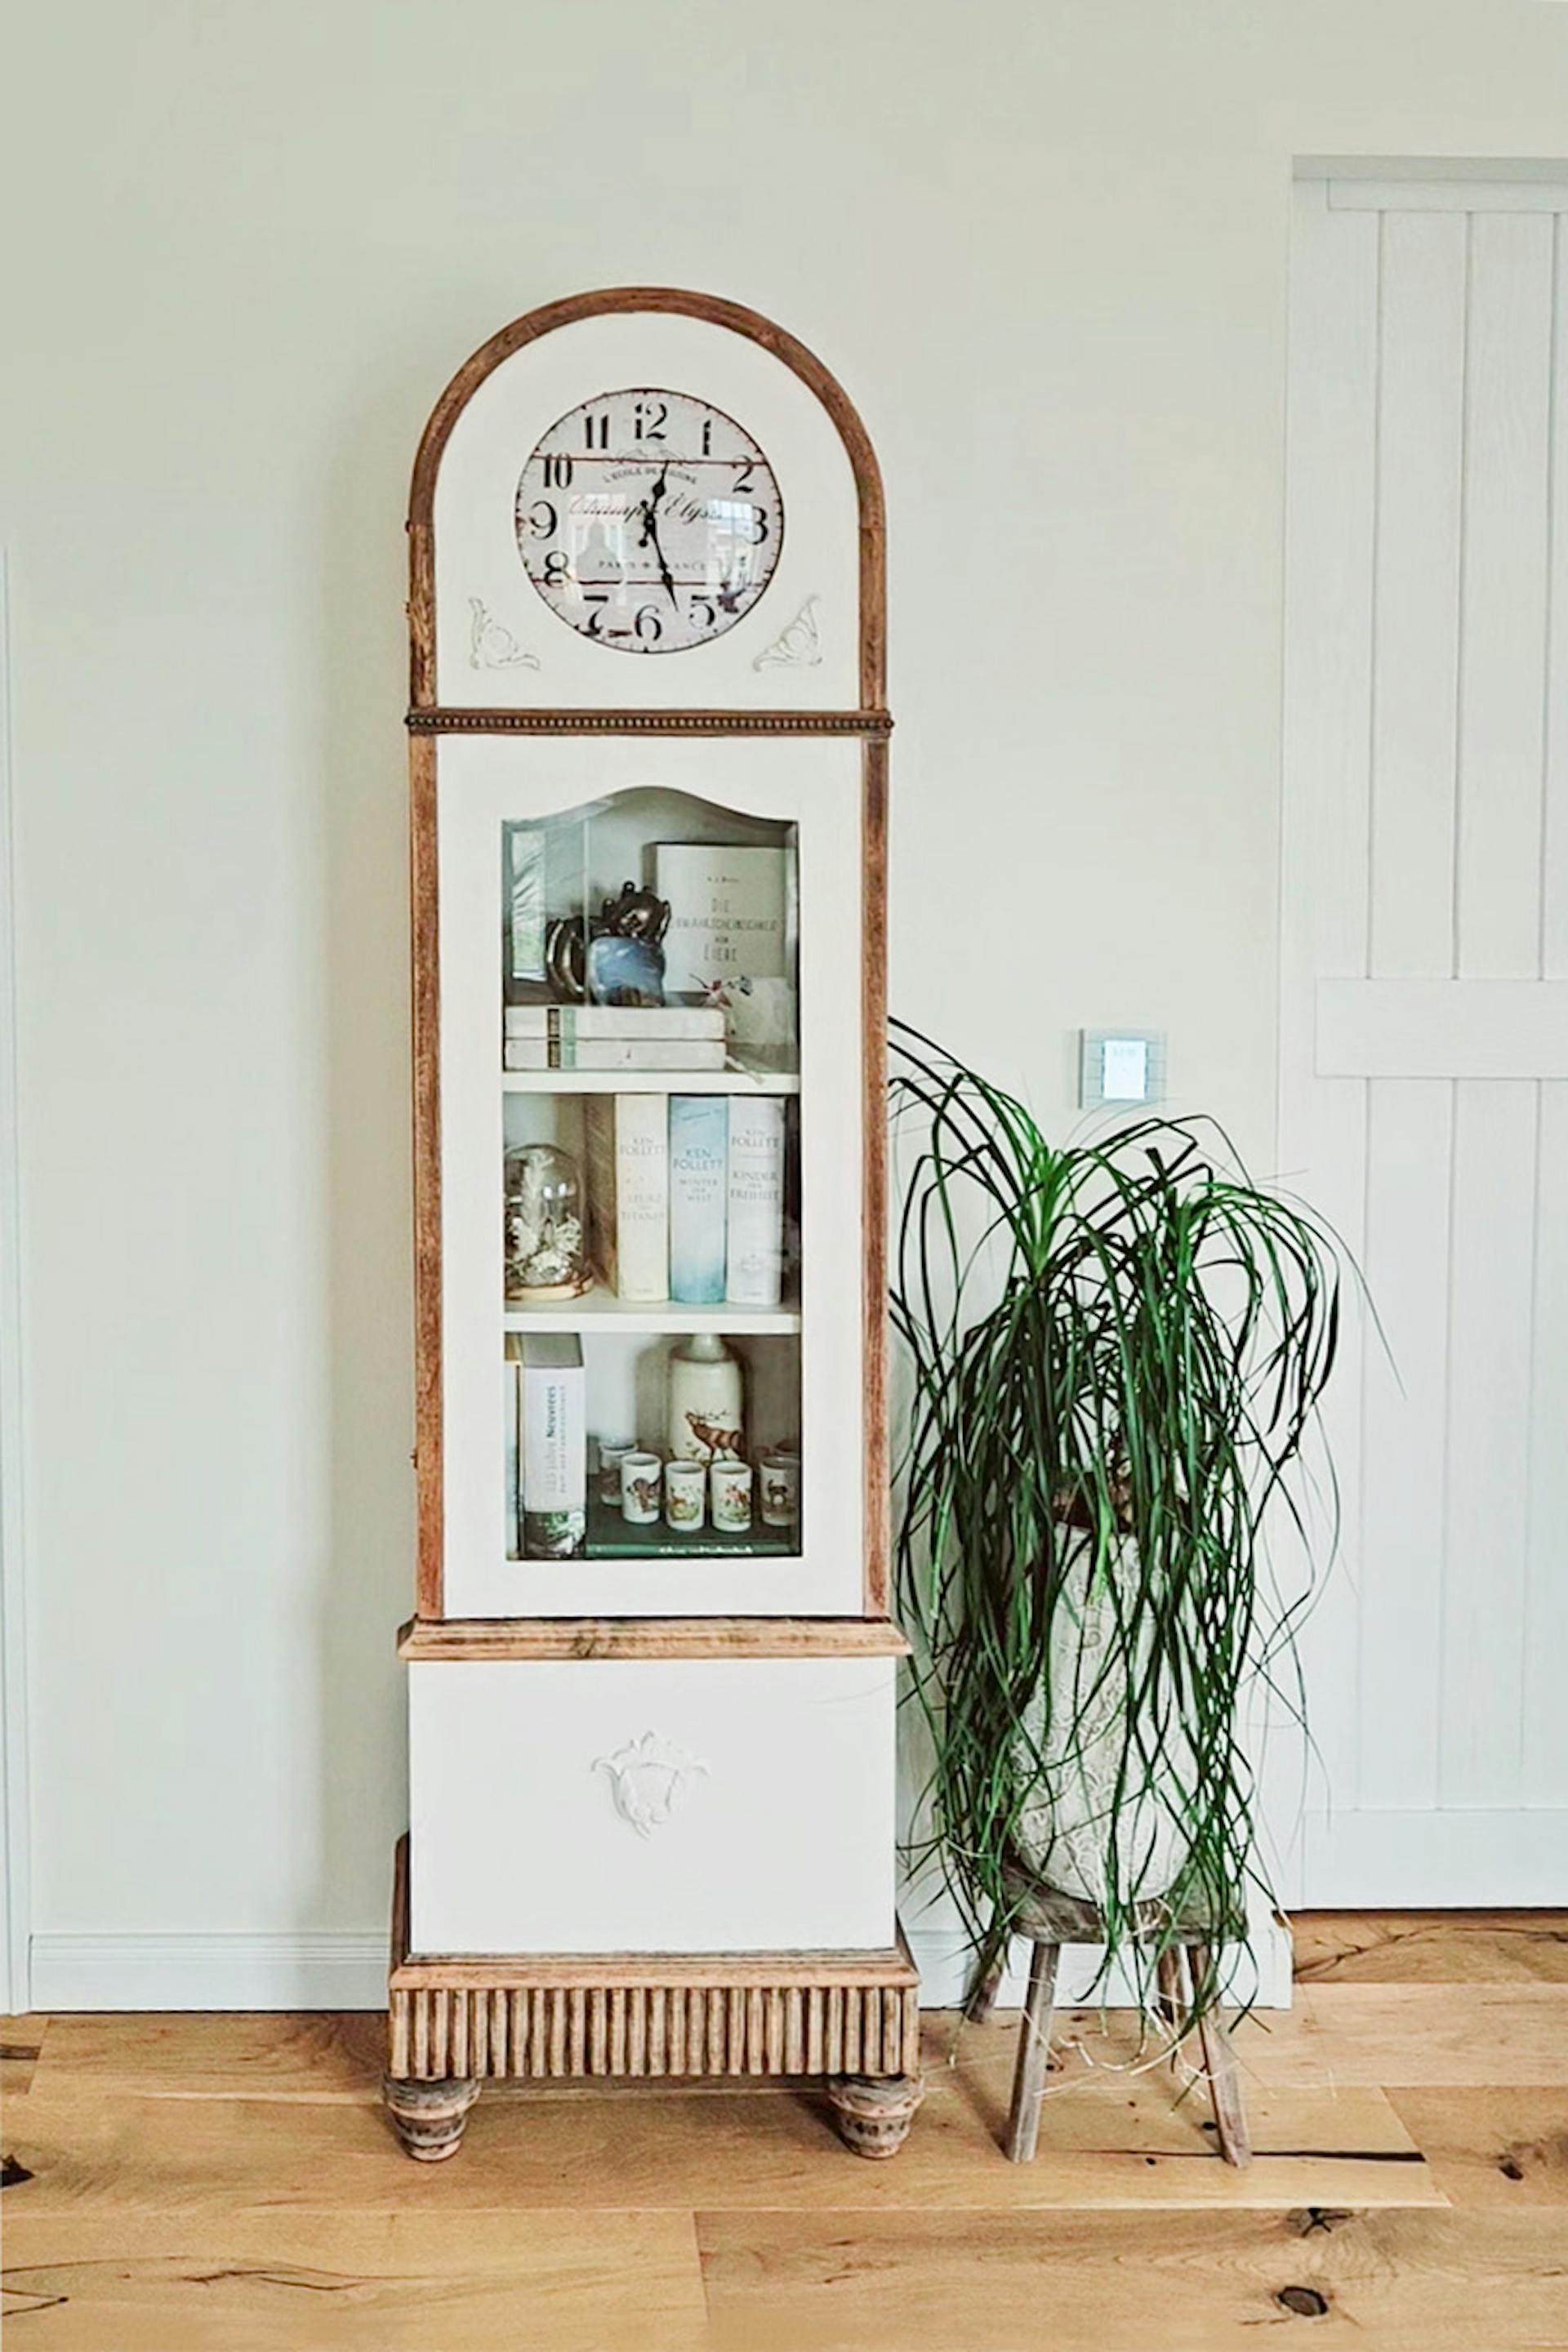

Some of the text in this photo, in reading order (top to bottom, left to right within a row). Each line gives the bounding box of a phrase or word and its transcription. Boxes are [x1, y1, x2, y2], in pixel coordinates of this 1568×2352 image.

[585, 414, 609, 449] 11
[635, 403, 667, 440] 12
[702, 419, 712, 456] 1
[543, 453, 572, 489] 10
[733, 454, 754, 493] 2
[530, 501, 557, 540] 9
[751, 506, 769, 546] 3
[543, 550, 569, 589] 8
[582, 595, 609, 636] 7
[634, 604, 662, 641] 6
[690, 595, 715, 626] 5
[685, 1148, 712, 1159] KEN
[731, 1136, 781, 1148] FOLLETT
[673, 1158, 724, 1171] FOLLETT
